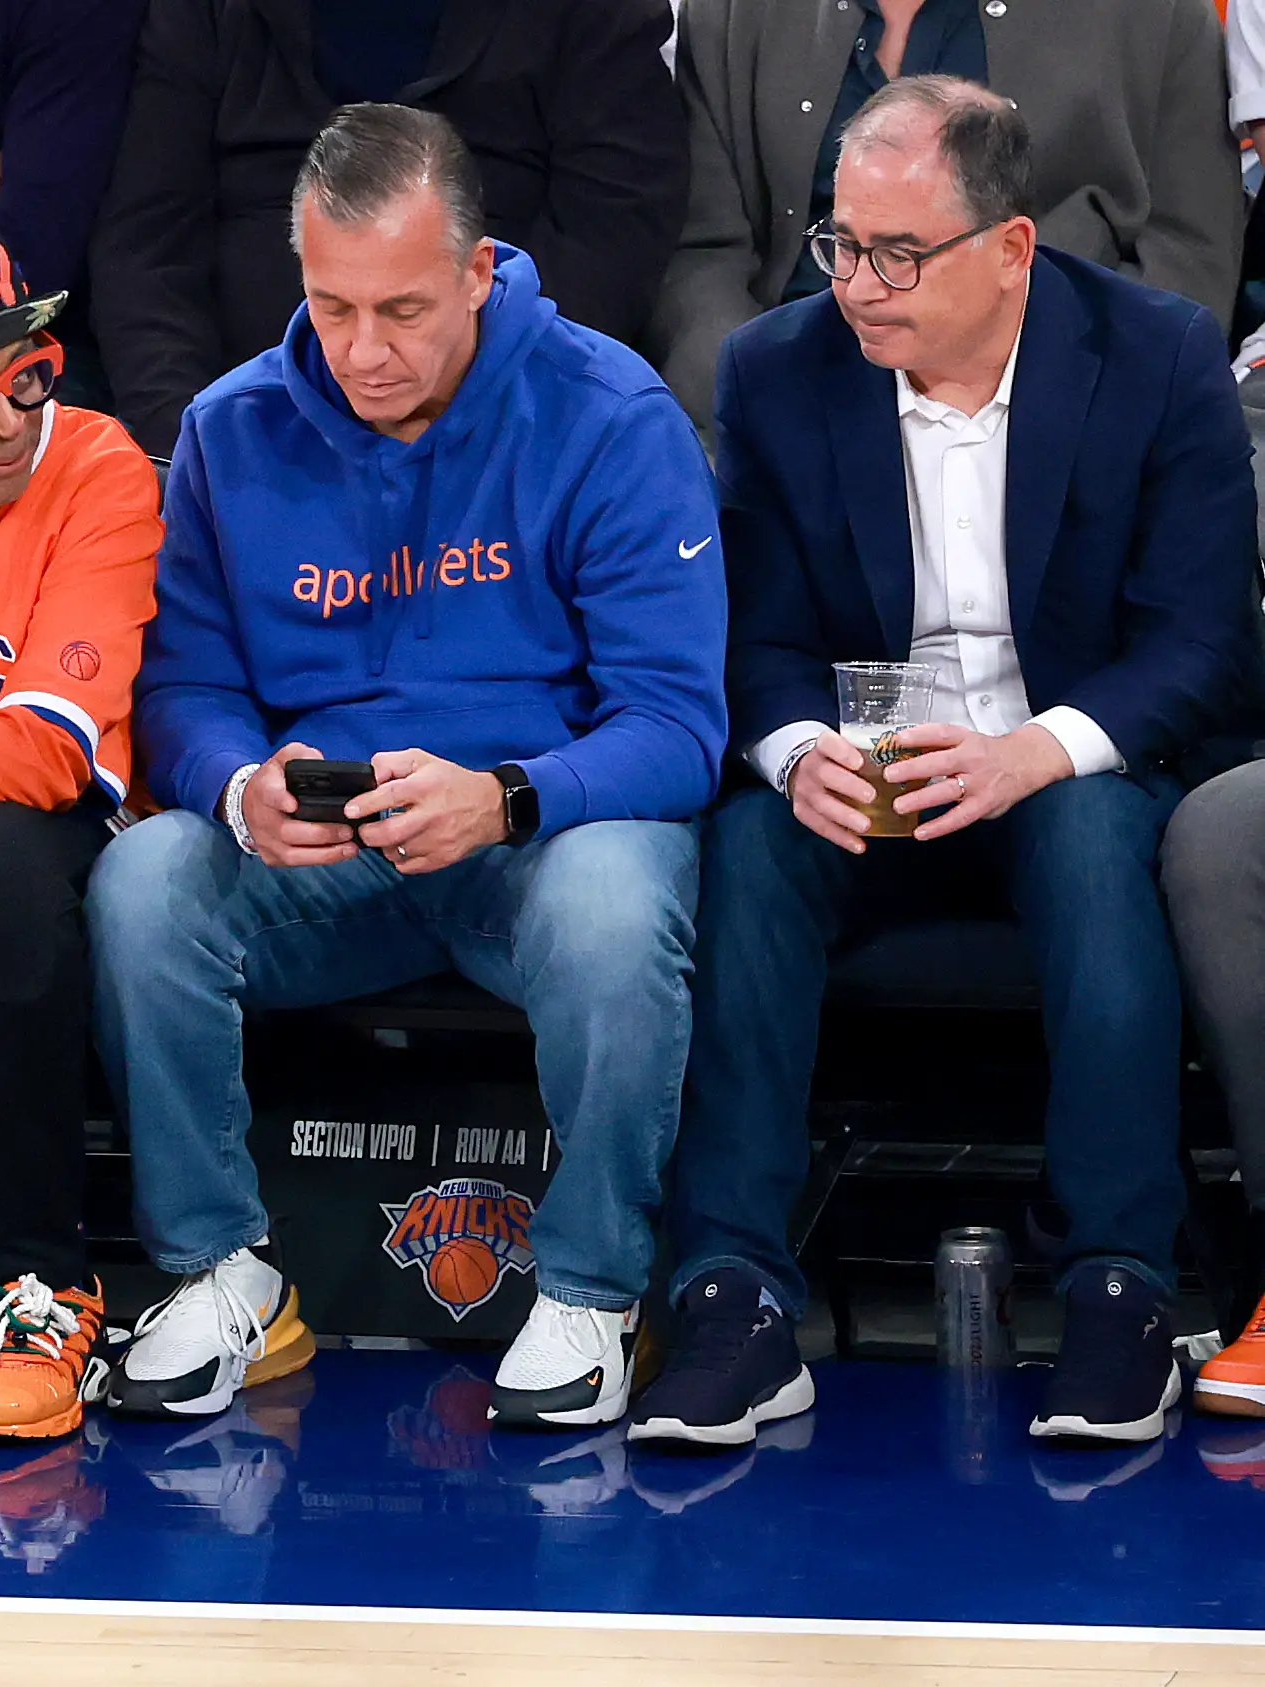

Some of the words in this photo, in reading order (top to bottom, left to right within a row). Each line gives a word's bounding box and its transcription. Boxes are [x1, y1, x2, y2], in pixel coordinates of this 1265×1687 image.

[291, 1120, 365, 1159] SECTION
[454, 1127, 499, 1164] ROW
[500, 1130, 526, 1165] AA
[440, 1180, 468, 1196] NEW
[470, 1182, 502, 1198] YORK
[388, 1194, 532, 1250] KNICKS
